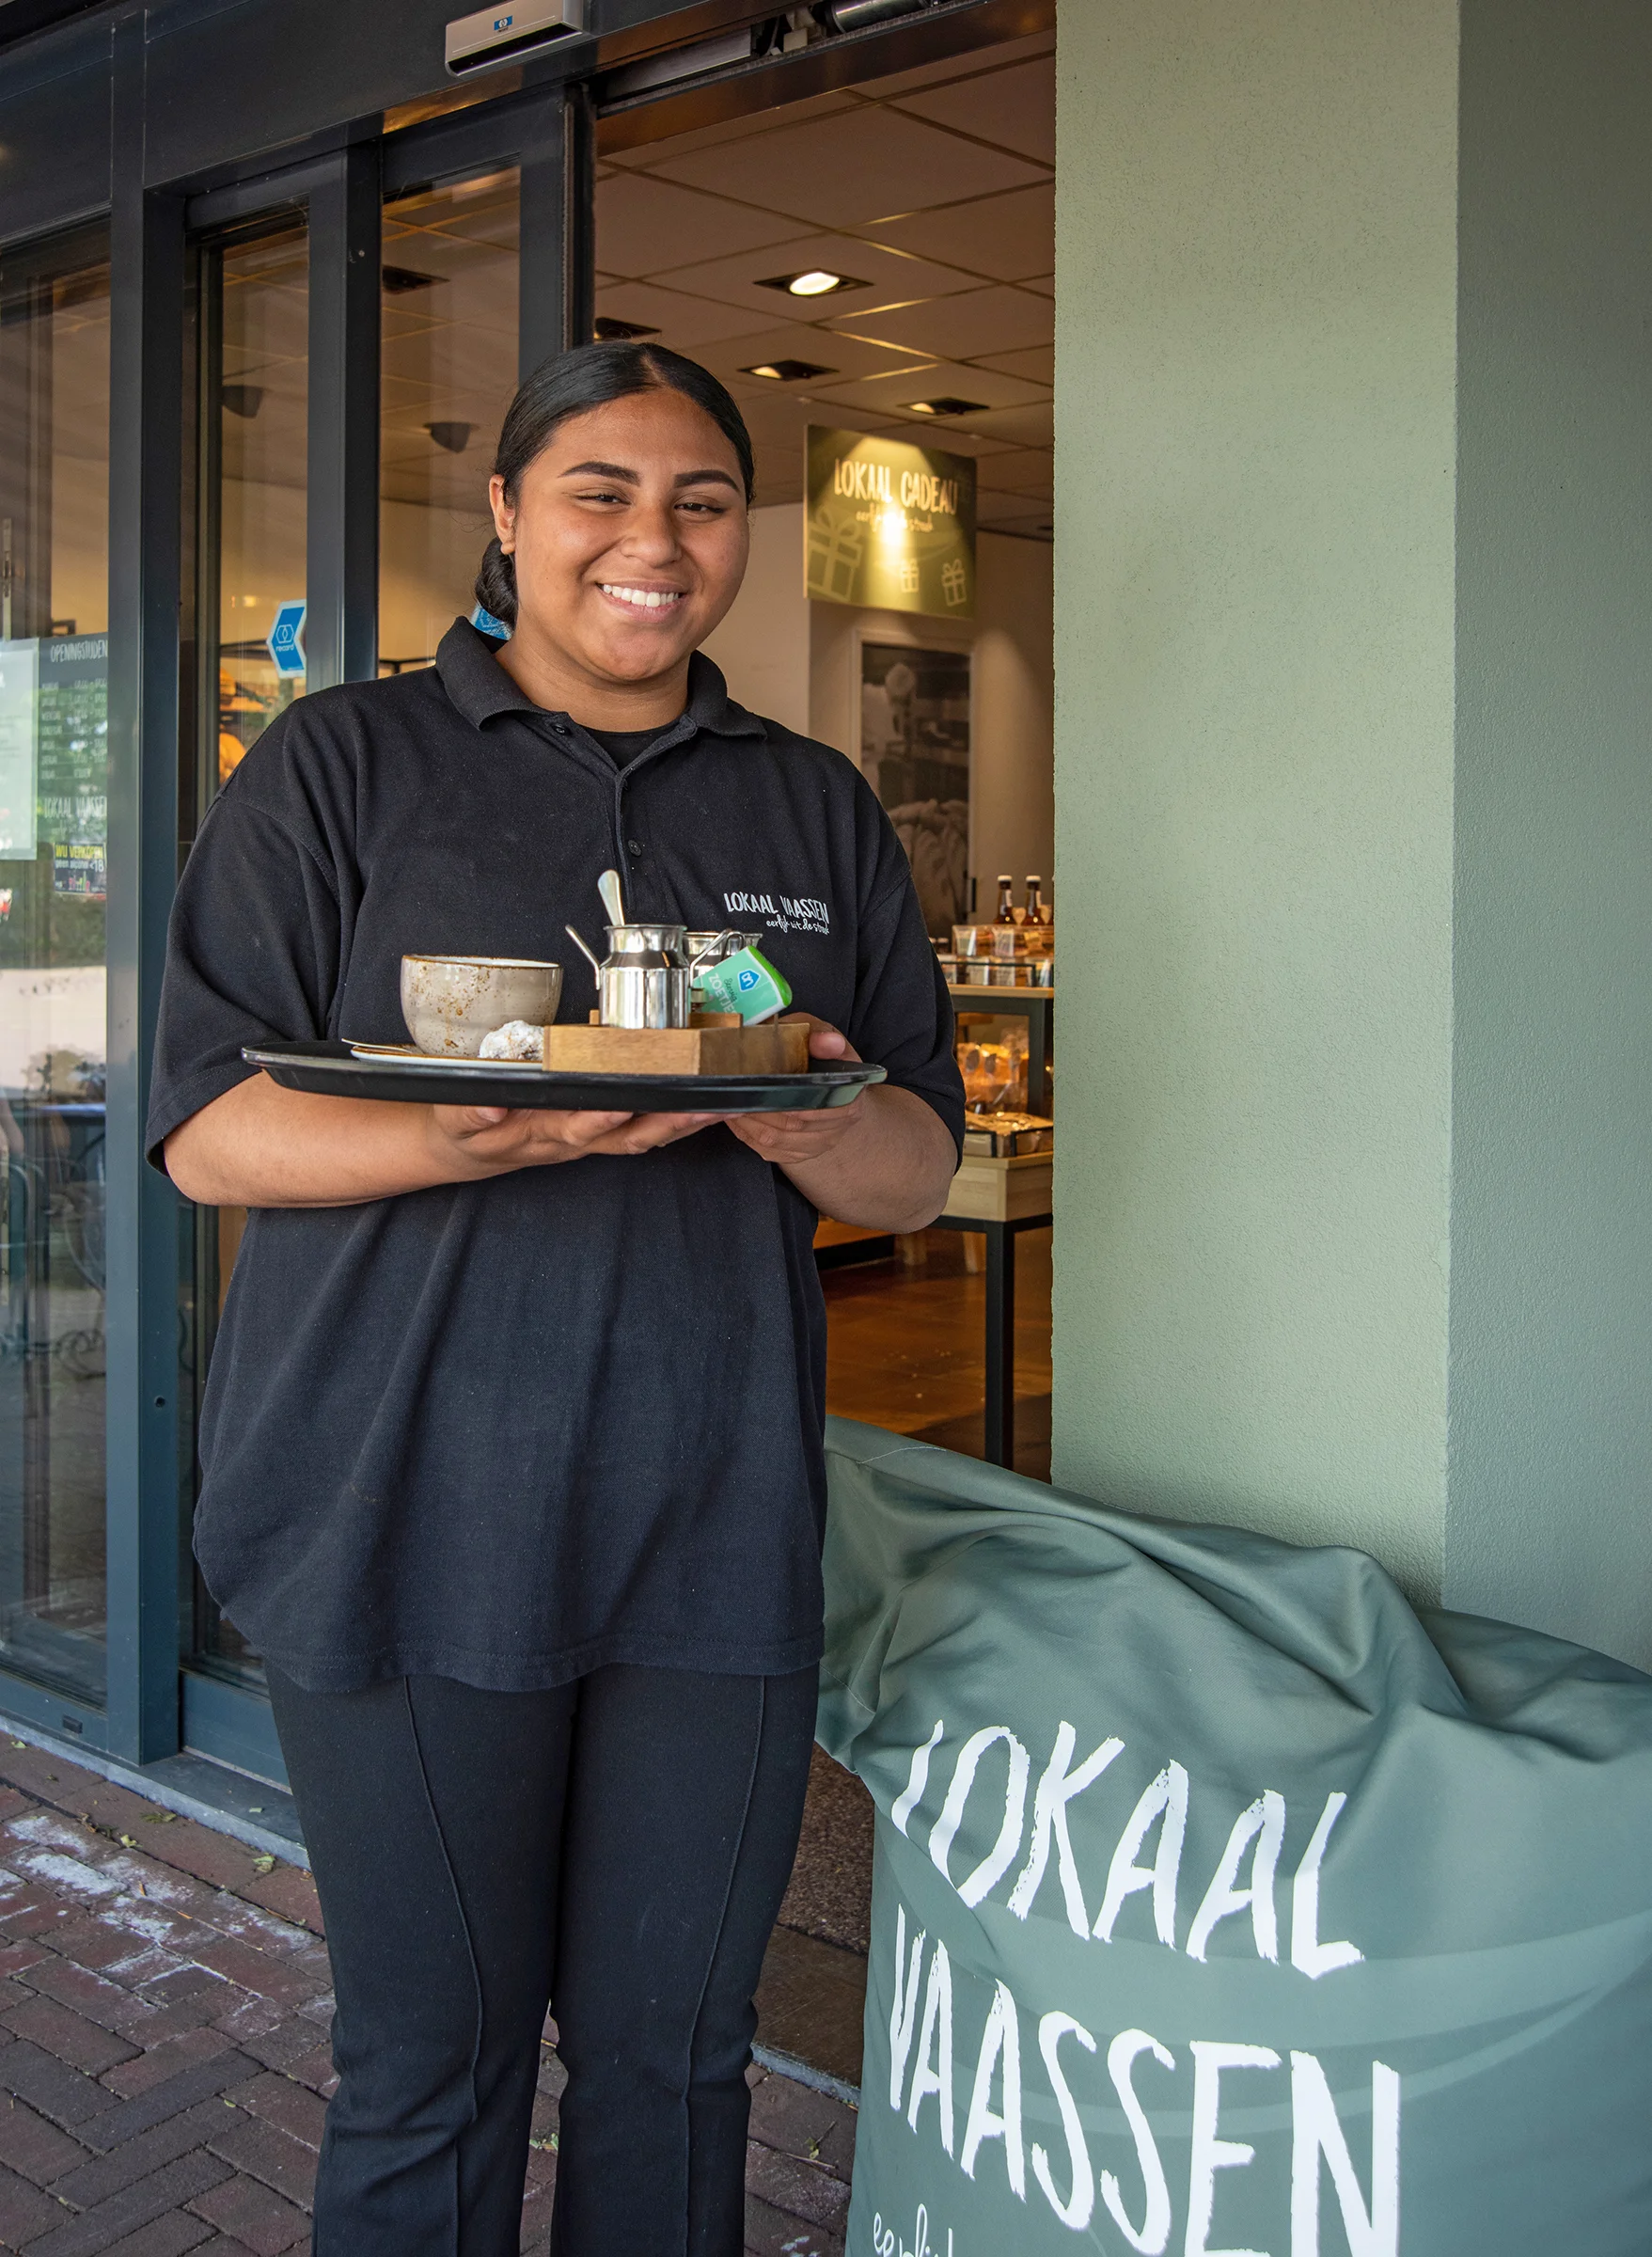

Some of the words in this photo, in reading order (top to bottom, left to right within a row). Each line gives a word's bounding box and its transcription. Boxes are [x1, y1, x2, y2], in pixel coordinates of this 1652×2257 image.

[834, 457, 892, 503] LOKAAL
[901, 470, 957, 515] CADEAU
[723, 892, 779, 914] LOKAAL
[779, 895, 829, 924] VAASSEN
[766, 914, 790, 933] eerlijk
[790, 920, 803, 930] uit
[802, 918, 813, 931] de
[708, 972, 738, 1013] ZOETJE
[890, 1720, 1365, 1980] LOKAAL
[889, 1902, 1401, 2257] VAASSEN
